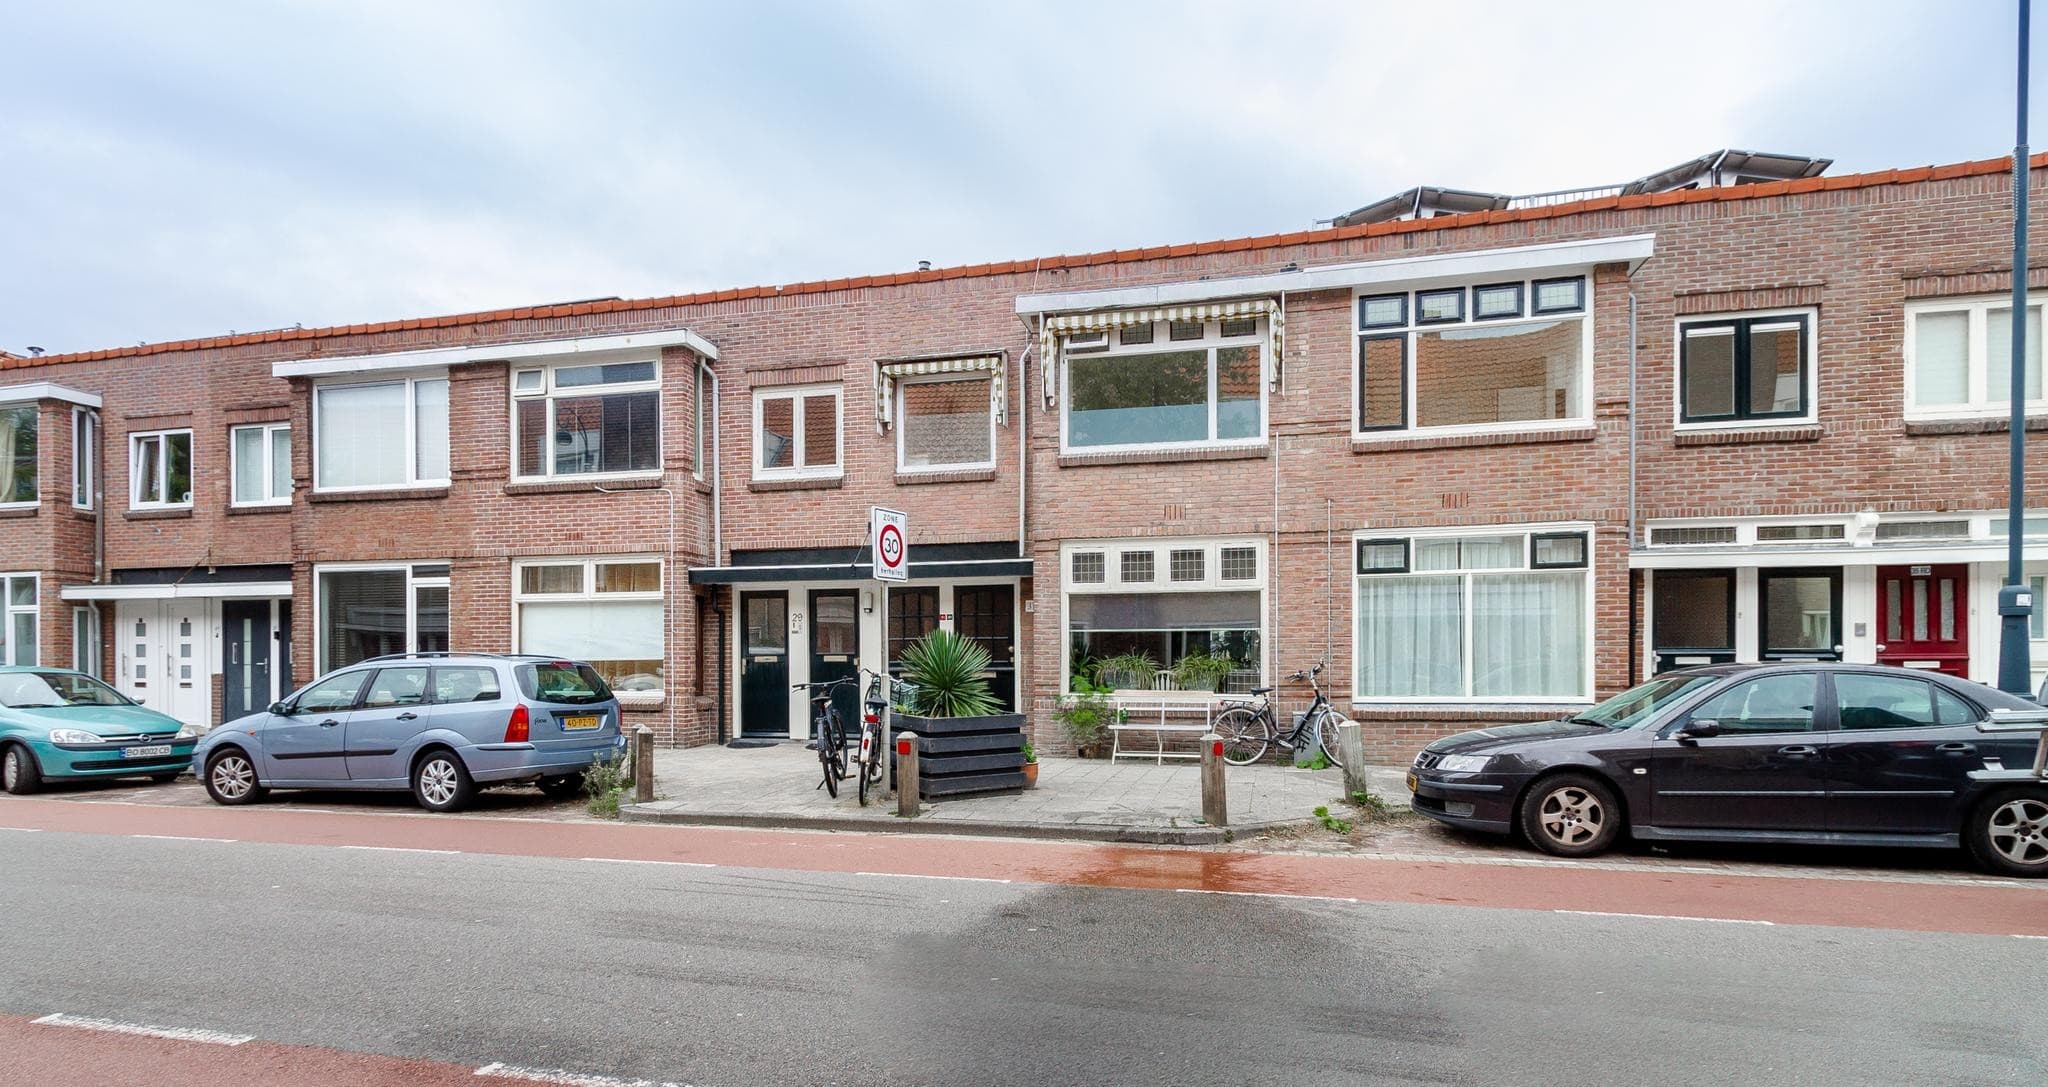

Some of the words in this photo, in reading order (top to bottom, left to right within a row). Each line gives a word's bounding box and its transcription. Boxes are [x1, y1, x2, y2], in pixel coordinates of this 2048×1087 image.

[883, 513, 898, 523] ZONE
[884, 537, 899, 554] 30
[792, 613, 803, 622] 29
